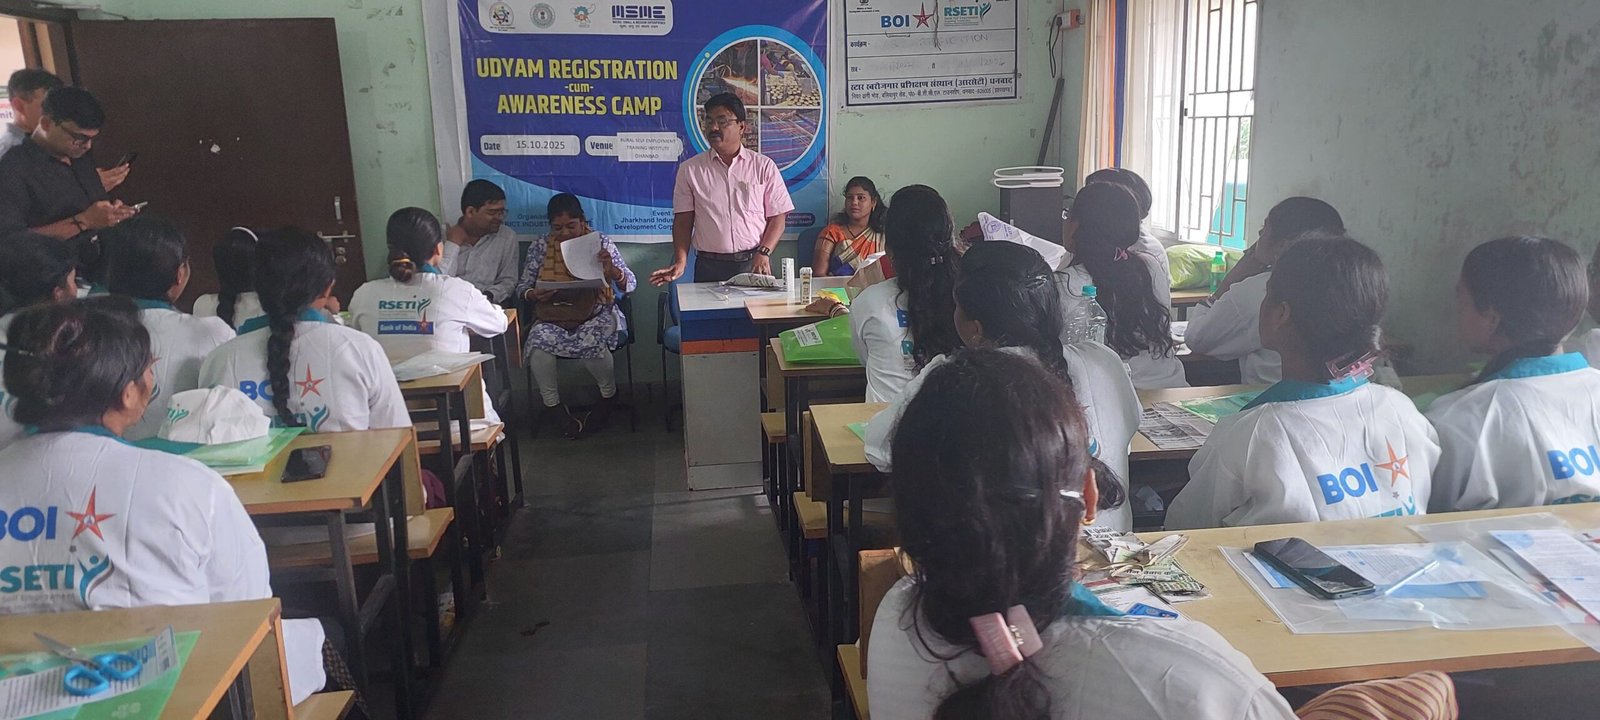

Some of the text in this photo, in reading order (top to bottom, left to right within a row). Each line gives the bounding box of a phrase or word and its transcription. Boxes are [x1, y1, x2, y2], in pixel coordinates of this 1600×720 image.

[612, 5, 666, 19] MSME
[944, 6, 978, 16] RSETI
[881, 15, 910, 28] BOI
[476, 58, 678, 80] UDYAM REGISTRATION
[564, 82, 594, 93] -cum-
[497, 94, 662, 116] AWARENESS CAMP
[483, 142, 501, 151] Date
[516, 140, 565, 150] 15.10.2025
[590, 141, 614, 150] Venue
[379, 300, 416, 309] RSETI
[380, 323, 394, 331] Bank
[240, 380, 274, 400] BO
[1316, 462, 1378, 506] BOI
